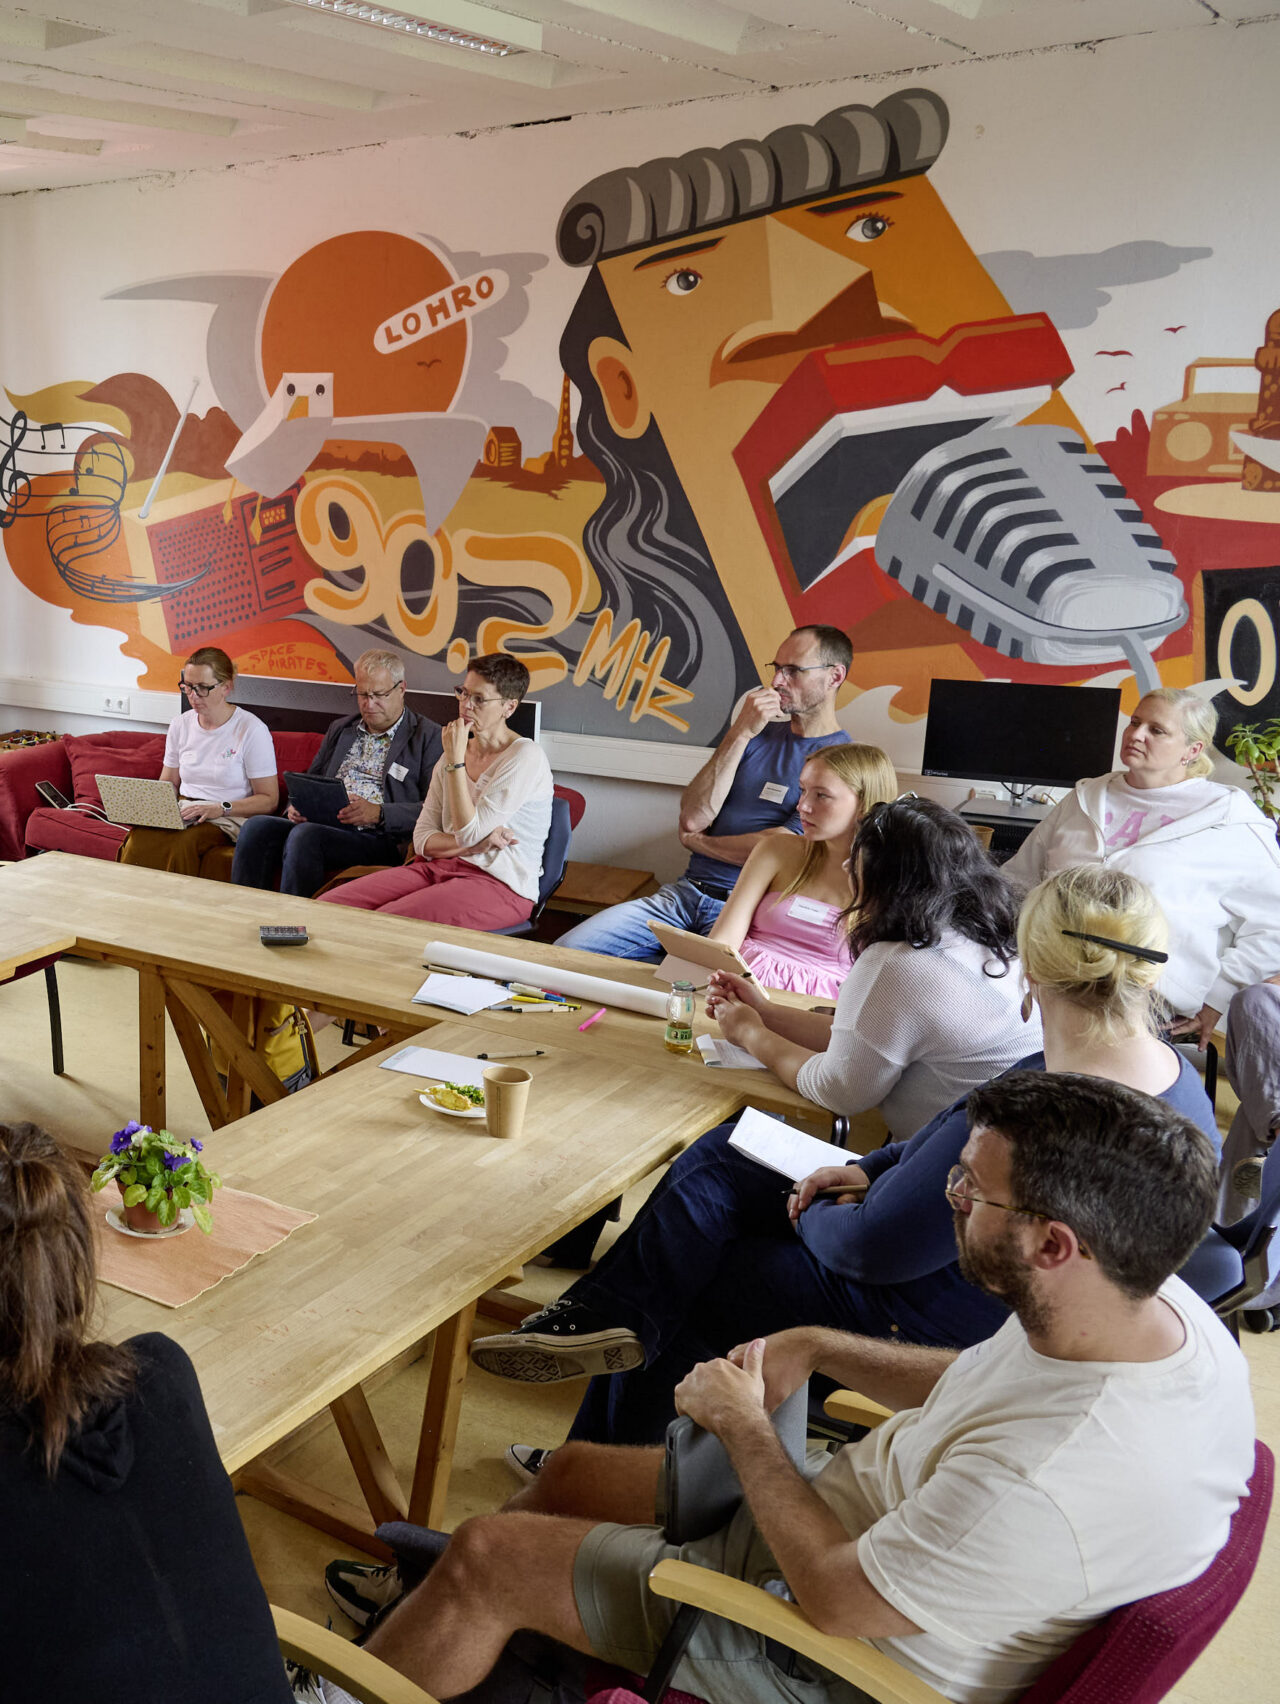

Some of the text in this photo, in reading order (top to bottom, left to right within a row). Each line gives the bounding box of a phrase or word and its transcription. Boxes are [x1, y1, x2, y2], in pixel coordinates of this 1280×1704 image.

[384, 275, 494, 345] LOHRO
[294, 474, 589, 694] 90.2
[248, 643, 297, 665] SPACE
